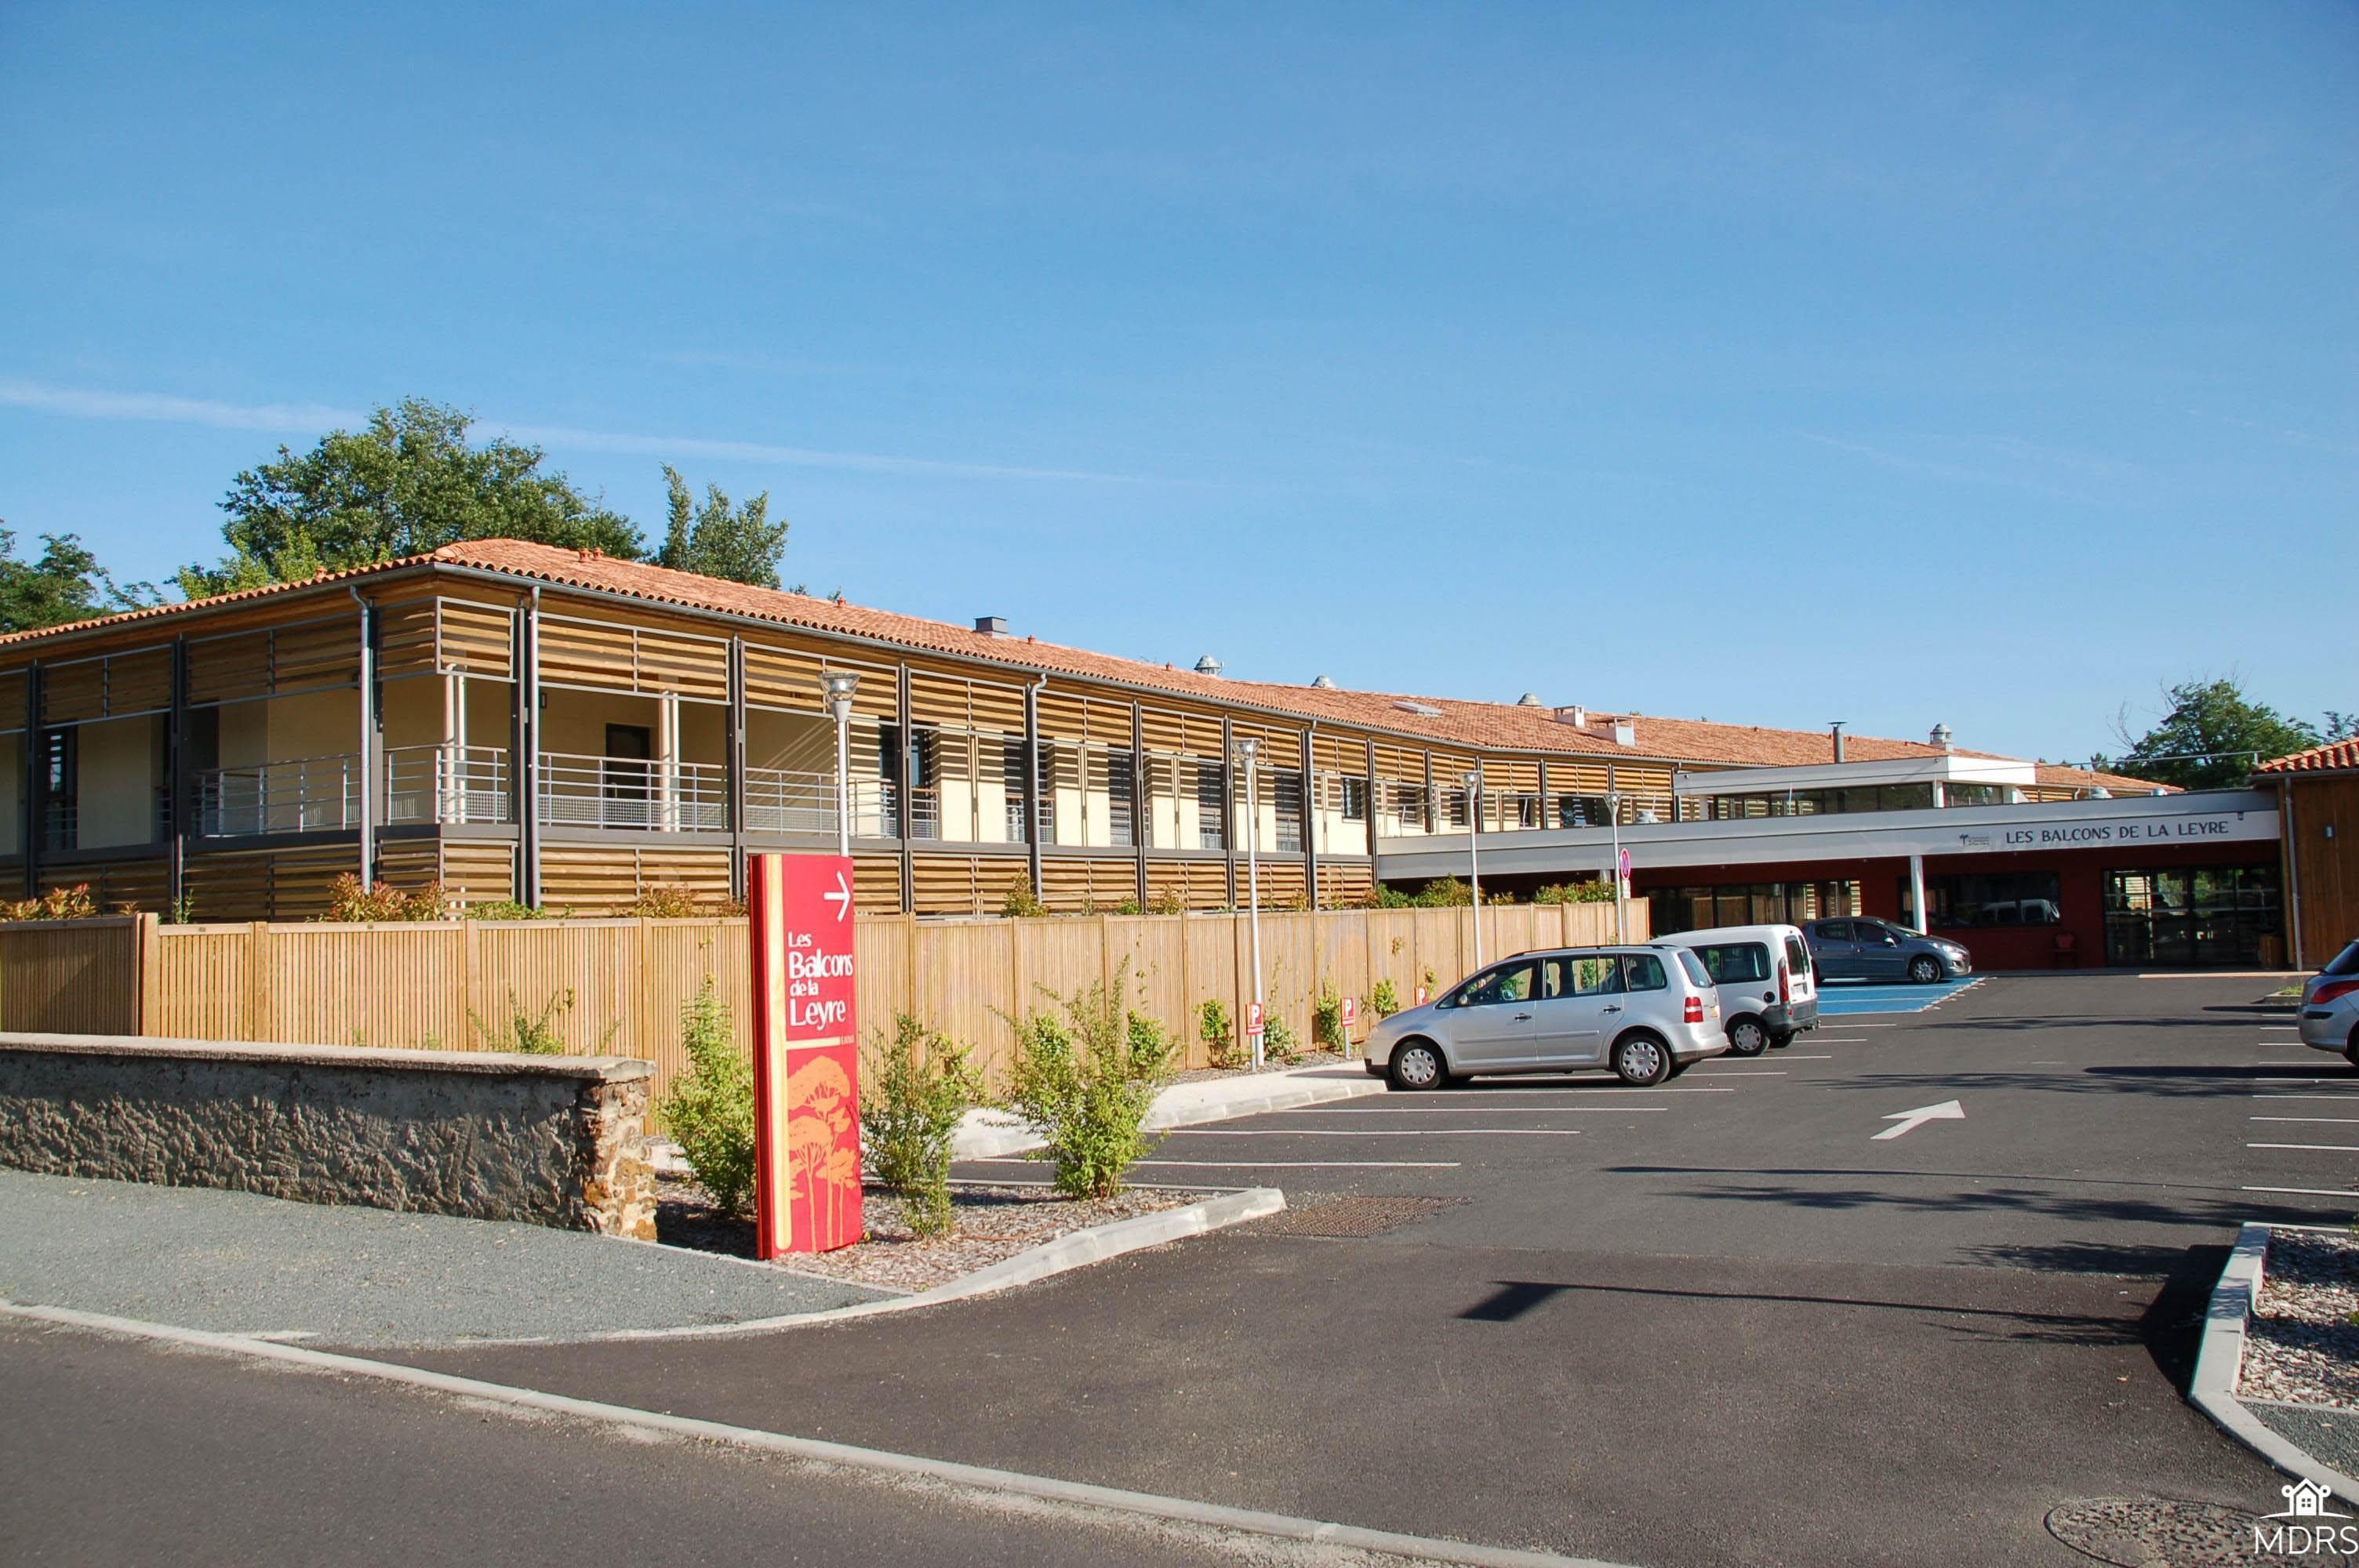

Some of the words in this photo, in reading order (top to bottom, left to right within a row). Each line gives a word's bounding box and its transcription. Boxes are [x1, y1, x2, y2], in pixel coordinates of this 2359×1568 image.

[2006, 830, 2034, 844] LES
[2041, 826, 2110, 842] BALCONS
[2119, 825, 2139, 839] DE
[2148, 824, 2169, 837] LA
[2178, 821, 2229, 836] LEYRE
[787, 931, 812, 948] Les
[788, 948, 853, 979] Balcons
[789, 980, 807, 997] de
[808, 979, 819, 996] la
[1419, 987, 1426, 1004] P
[789, 998, 846, 1031] Leyre
[1251, 1004, 1260, 1025] P
[1344, 998, 1352, 1017] P
